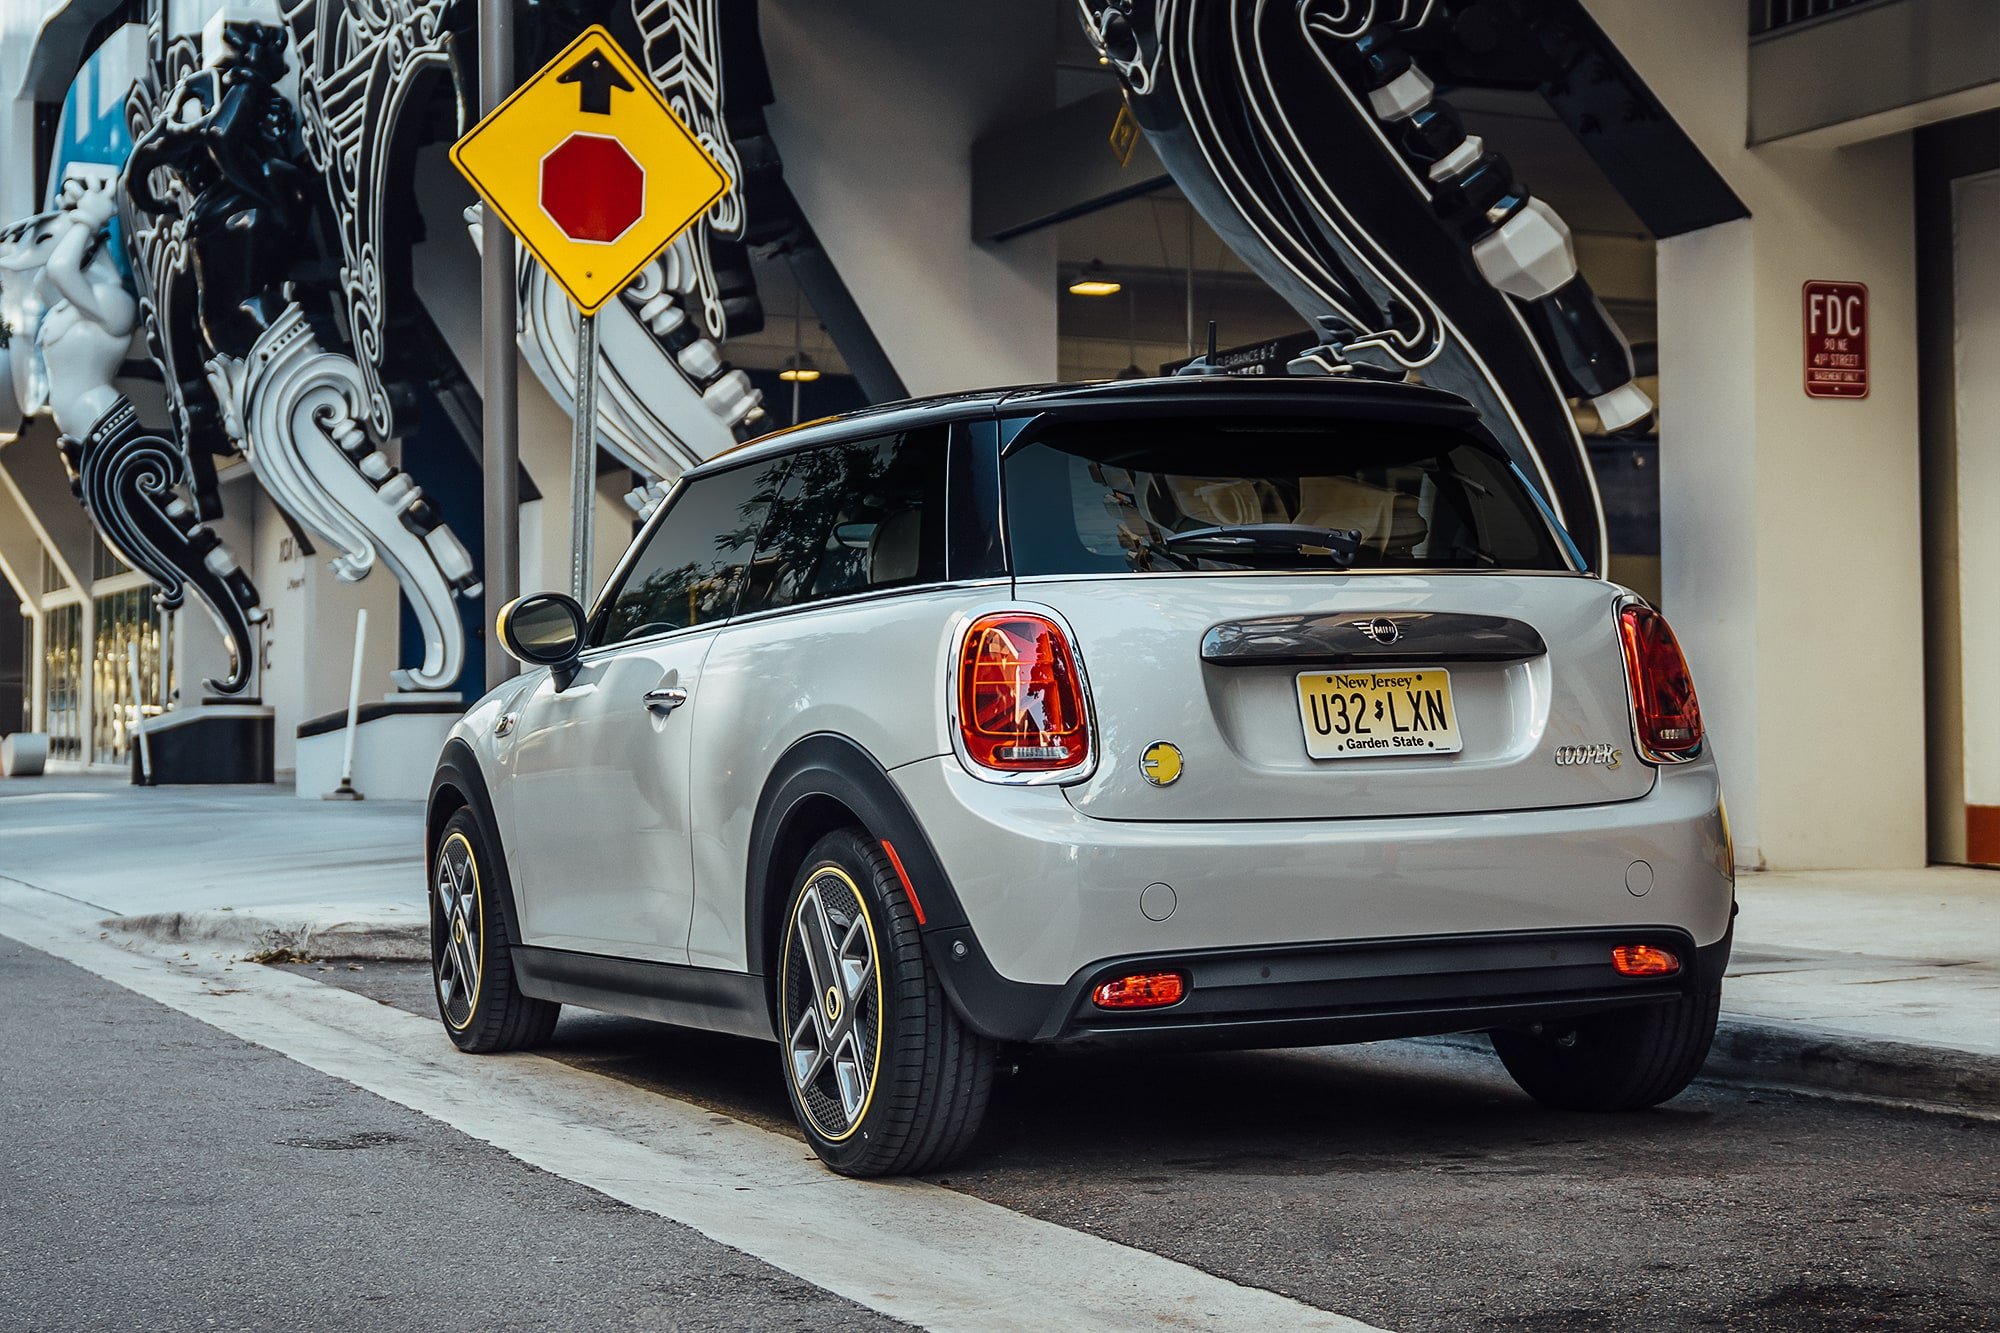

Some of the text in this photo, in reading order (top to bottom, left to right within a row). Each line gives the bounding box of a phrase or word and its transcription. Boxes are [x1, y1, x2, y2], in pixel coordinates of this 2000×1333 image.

[1810, 294, 1860, 336] FDC
[1838, 338, 1848, 351] NE
[1830, 353, 1859, 367] STREET
[1374, 625, 1395, 634] MINI
[1335, 674, 1413, 691] New Jersey
[1309, 690, 1448, 735] U32 LXN
[1346, 736, 1425, 750] Garden State
